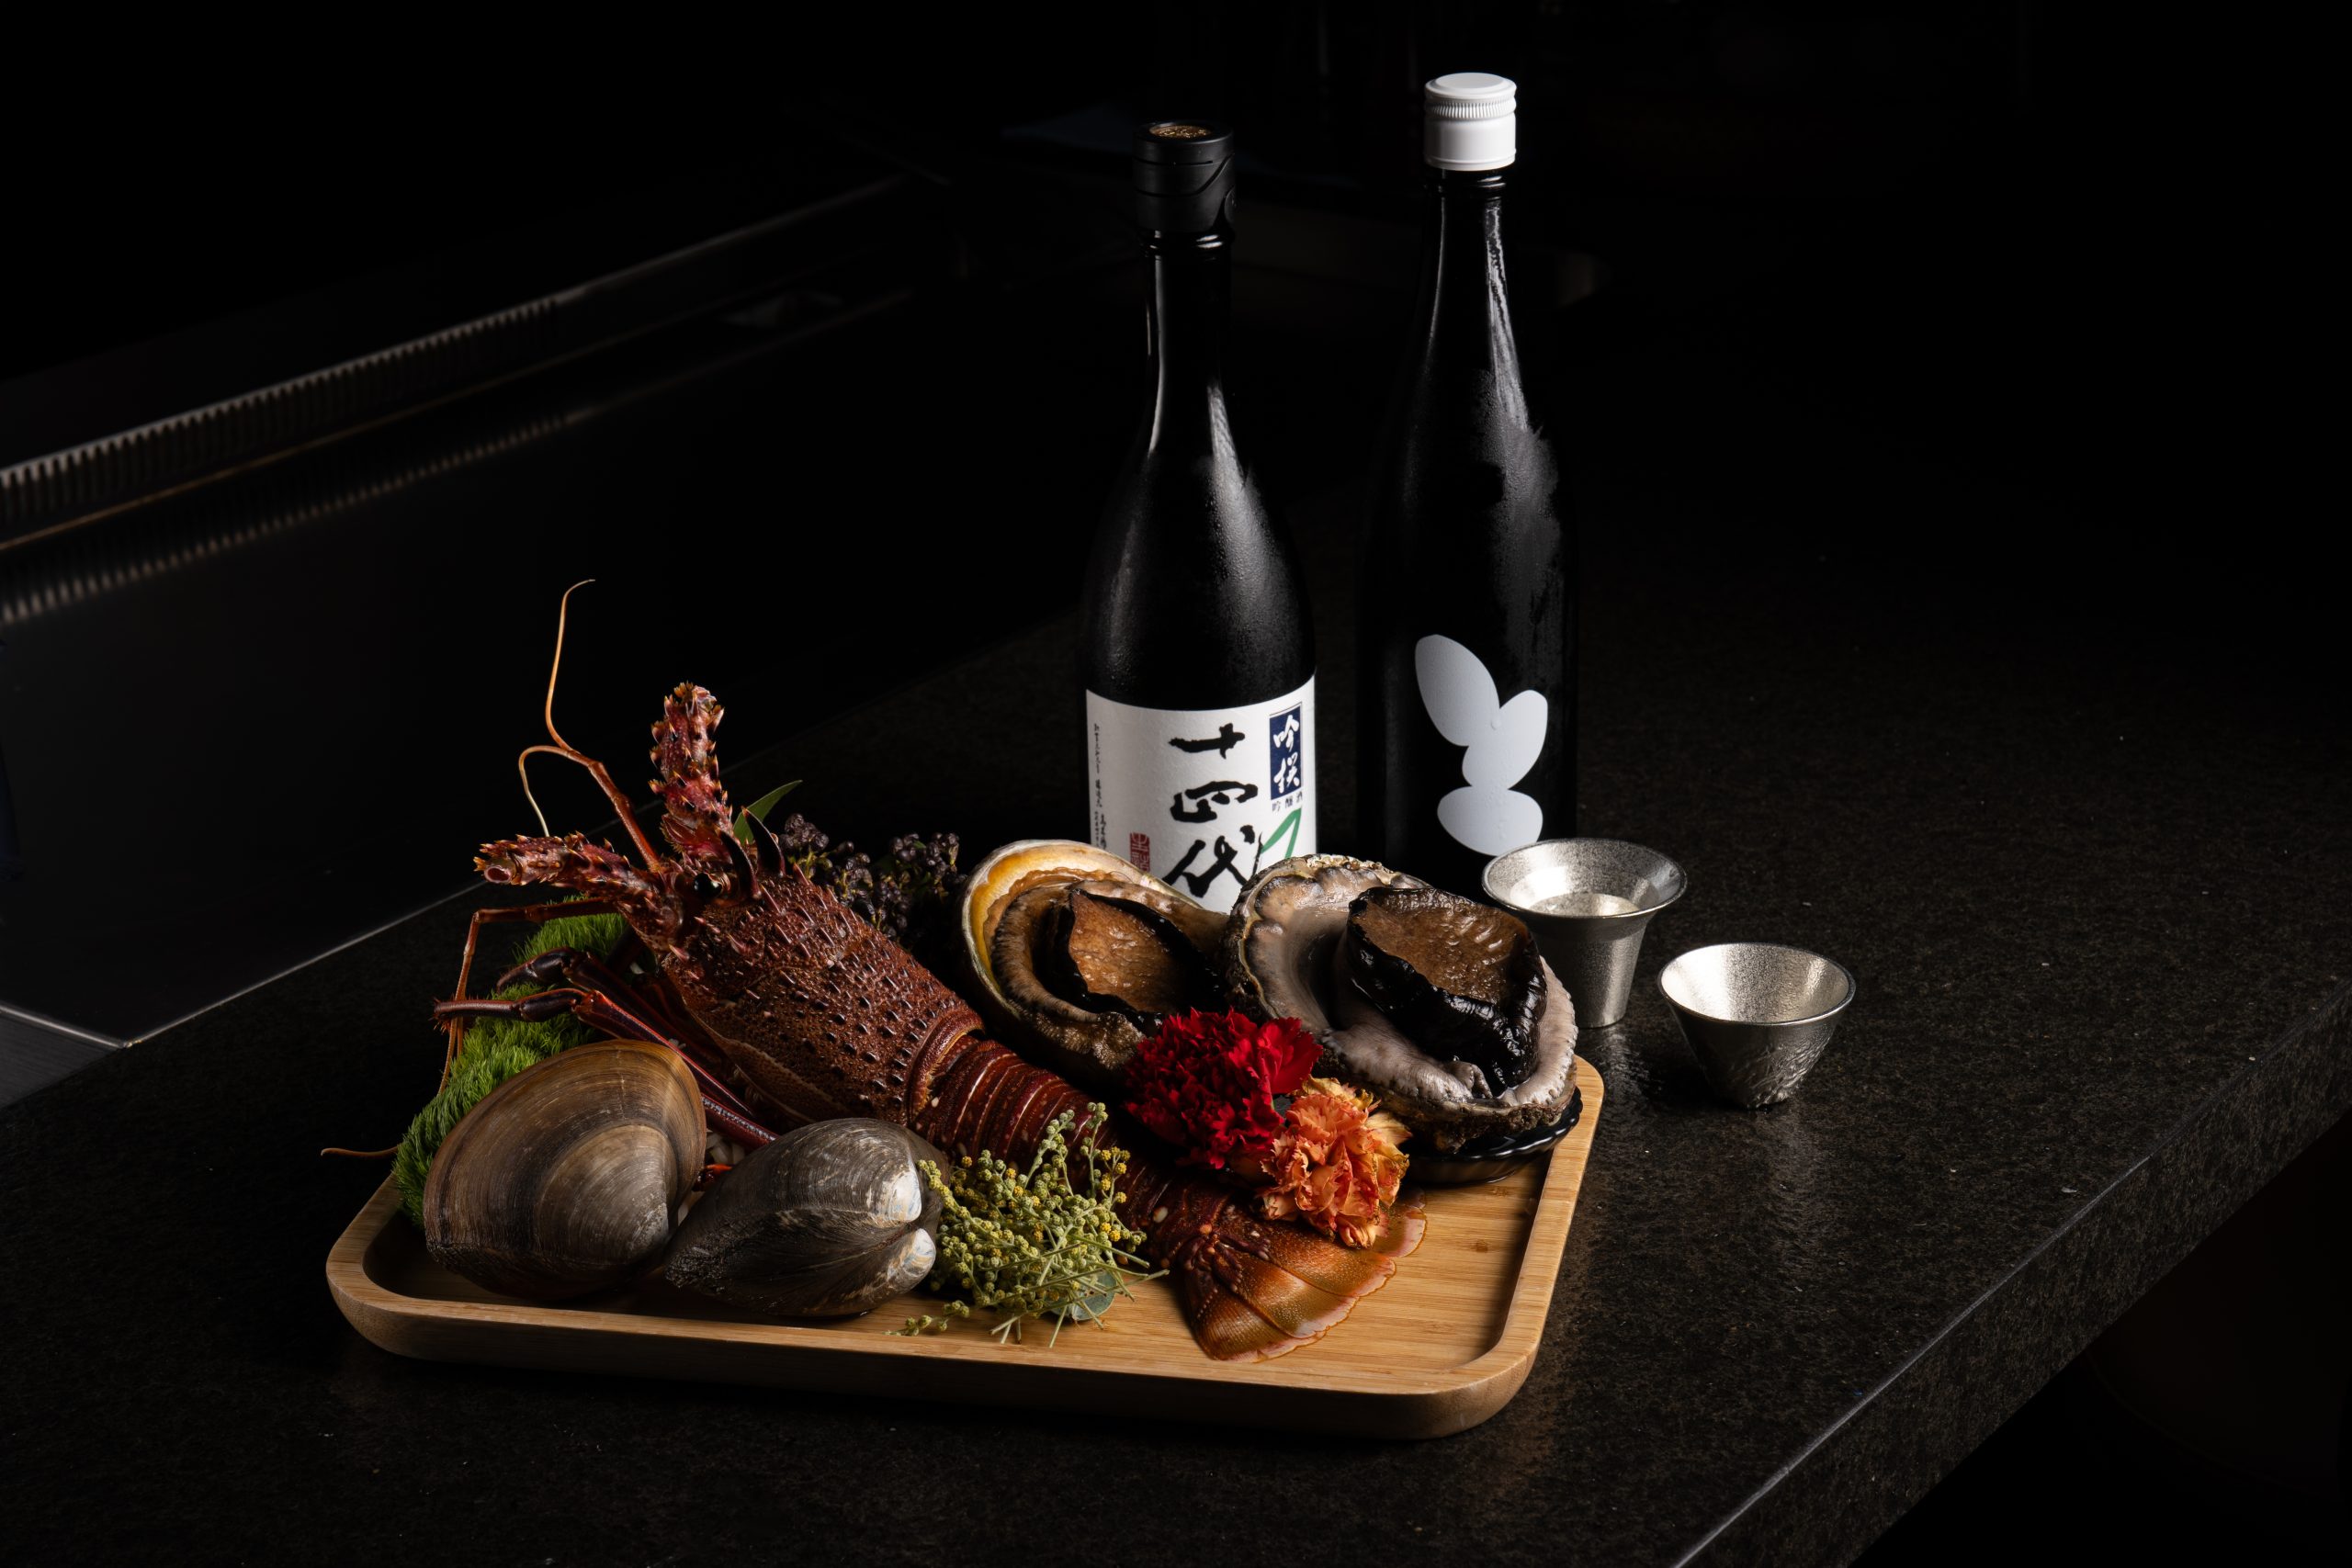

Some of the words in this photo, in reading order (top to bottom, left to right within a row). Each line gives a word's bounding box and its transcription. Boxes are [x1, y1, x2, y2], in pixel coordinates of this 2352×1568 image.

[1162, 723, 1263, 897] 十四代
[1272, 791, 1303, 812] 吟醸酒
